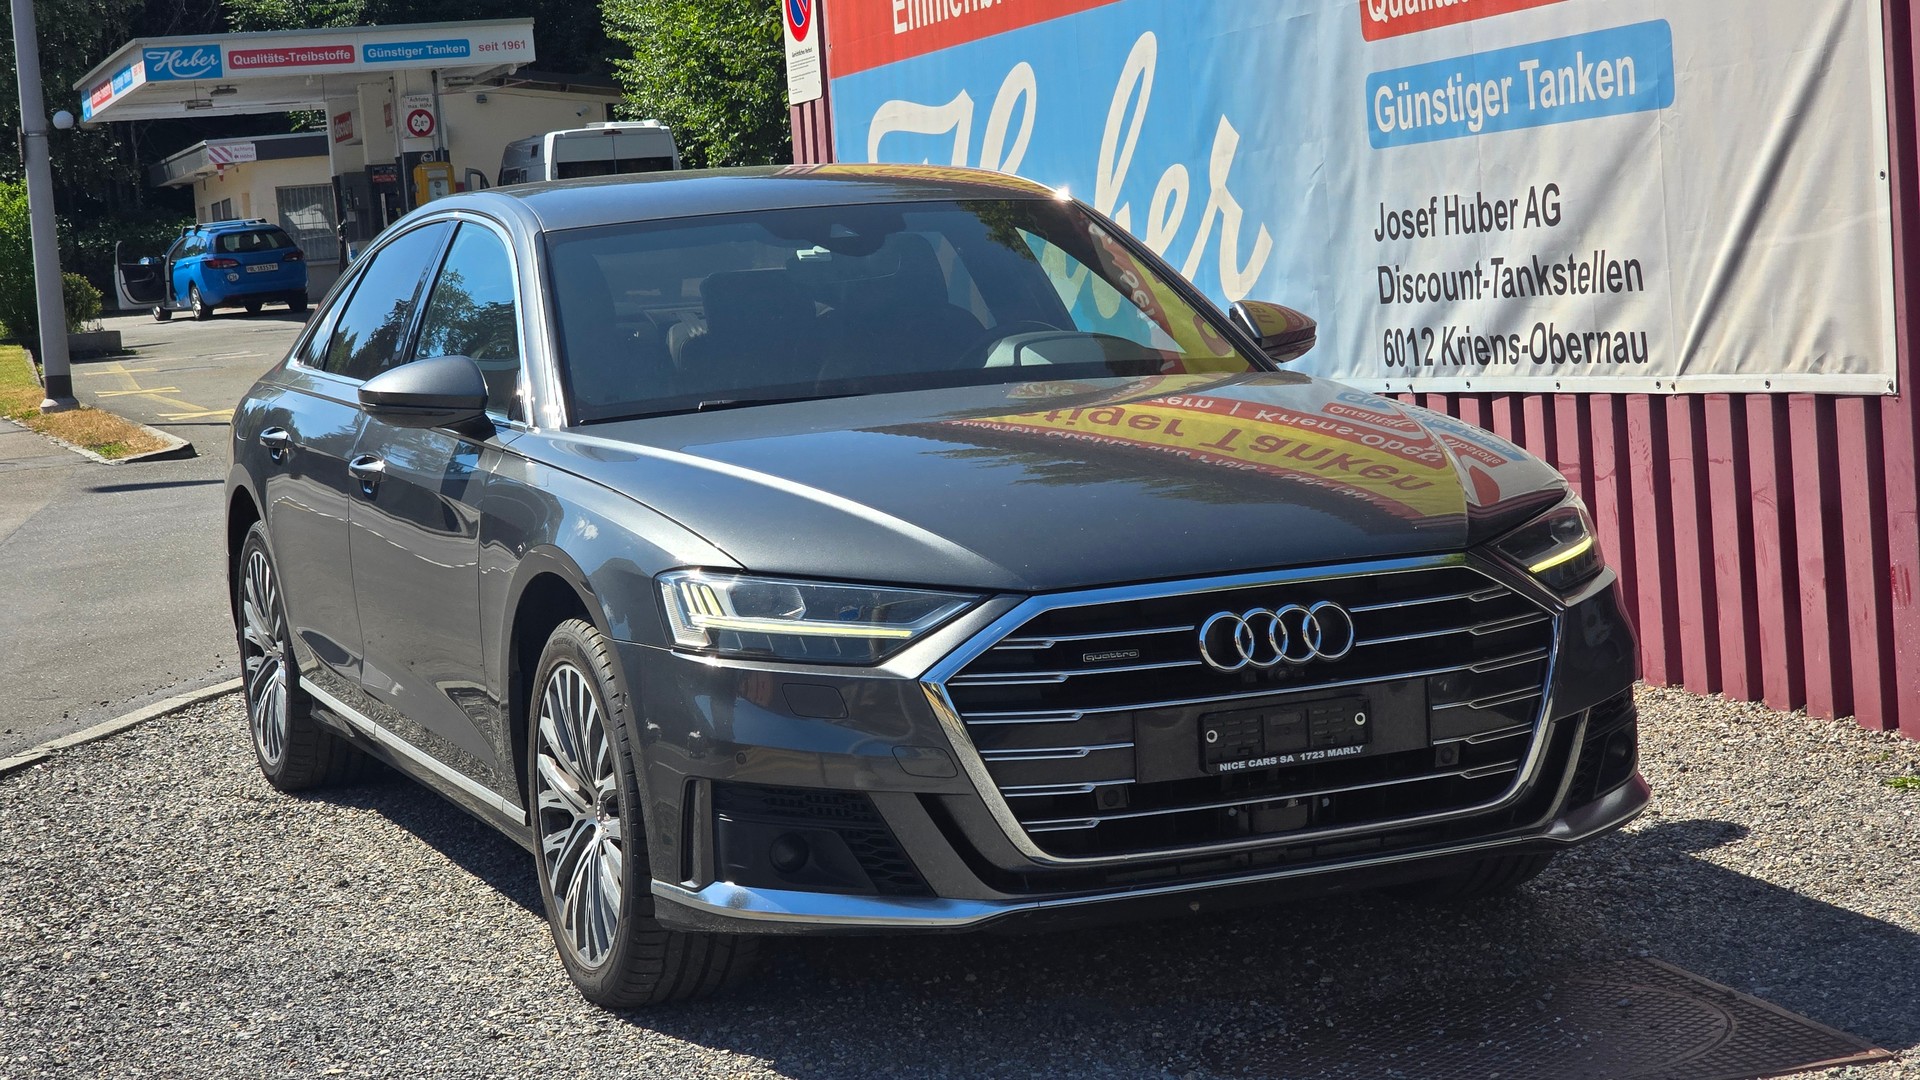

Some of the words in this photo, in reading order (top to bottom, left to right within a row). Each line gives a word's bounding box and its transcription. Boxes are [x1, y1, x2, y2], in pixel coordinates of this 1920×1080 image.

[233, 49, 351, 65] Qualitäts-Treibstoffe
[367, 47, 423, 59] Günstiger
[426, 44, 466, 55] Tanken
[478, 42, 499, 52] seit
[502, 40, 526, 51] 1961
[145, 48, 219, 78] Huber
[1374, 72, 1513, 133] Günstiger
[1519, 51, 1636, 110] Tanken
[1374, 196, 1438, 242] Josef
[1444, 191, 1519, 236] Huber
[1523, 183, 1561, 229] AG
[1377, 249, 1644, 305] Discount-Tankstellen
[1383, 327, 1435, 367] 6012
[1441, 322, 1649, 367] Kriens-Obernau
[1085, 651, 1138, 661] quattro
[1219, 760, 1246, 772] NICE
[1248, 756, 1277, 768] CARS
[1280, 754, 1294, 764] SA
[1300, 750, 1325, 761] 1723
[1327, 745, 1364, 757] MARLY
